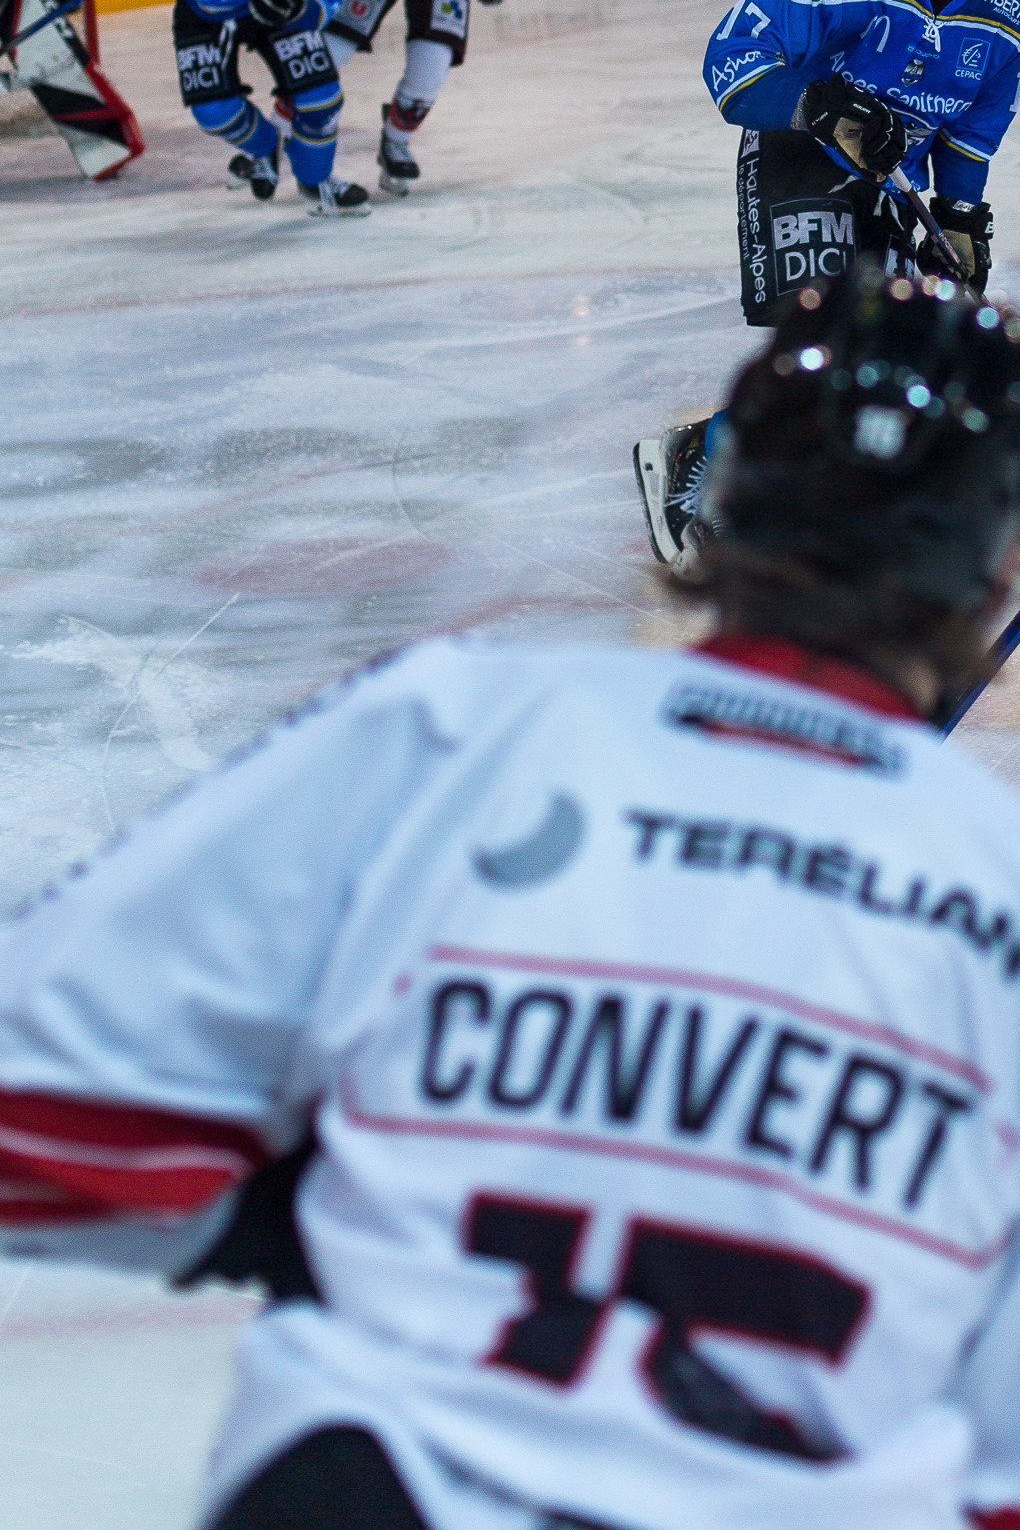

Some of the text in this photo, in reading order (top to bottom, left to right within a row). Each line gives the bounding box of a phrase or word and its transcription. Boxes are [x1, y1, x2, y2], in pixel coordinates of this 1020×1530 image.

[955, 69, 983, 82] CEPAC
[737, 176, 750, 261] département
[747, 157, 768, 304] Hautes-Alpes
[773, 210, 854, 251] BFM
[418, 978, 975, 1215] CONVERT
